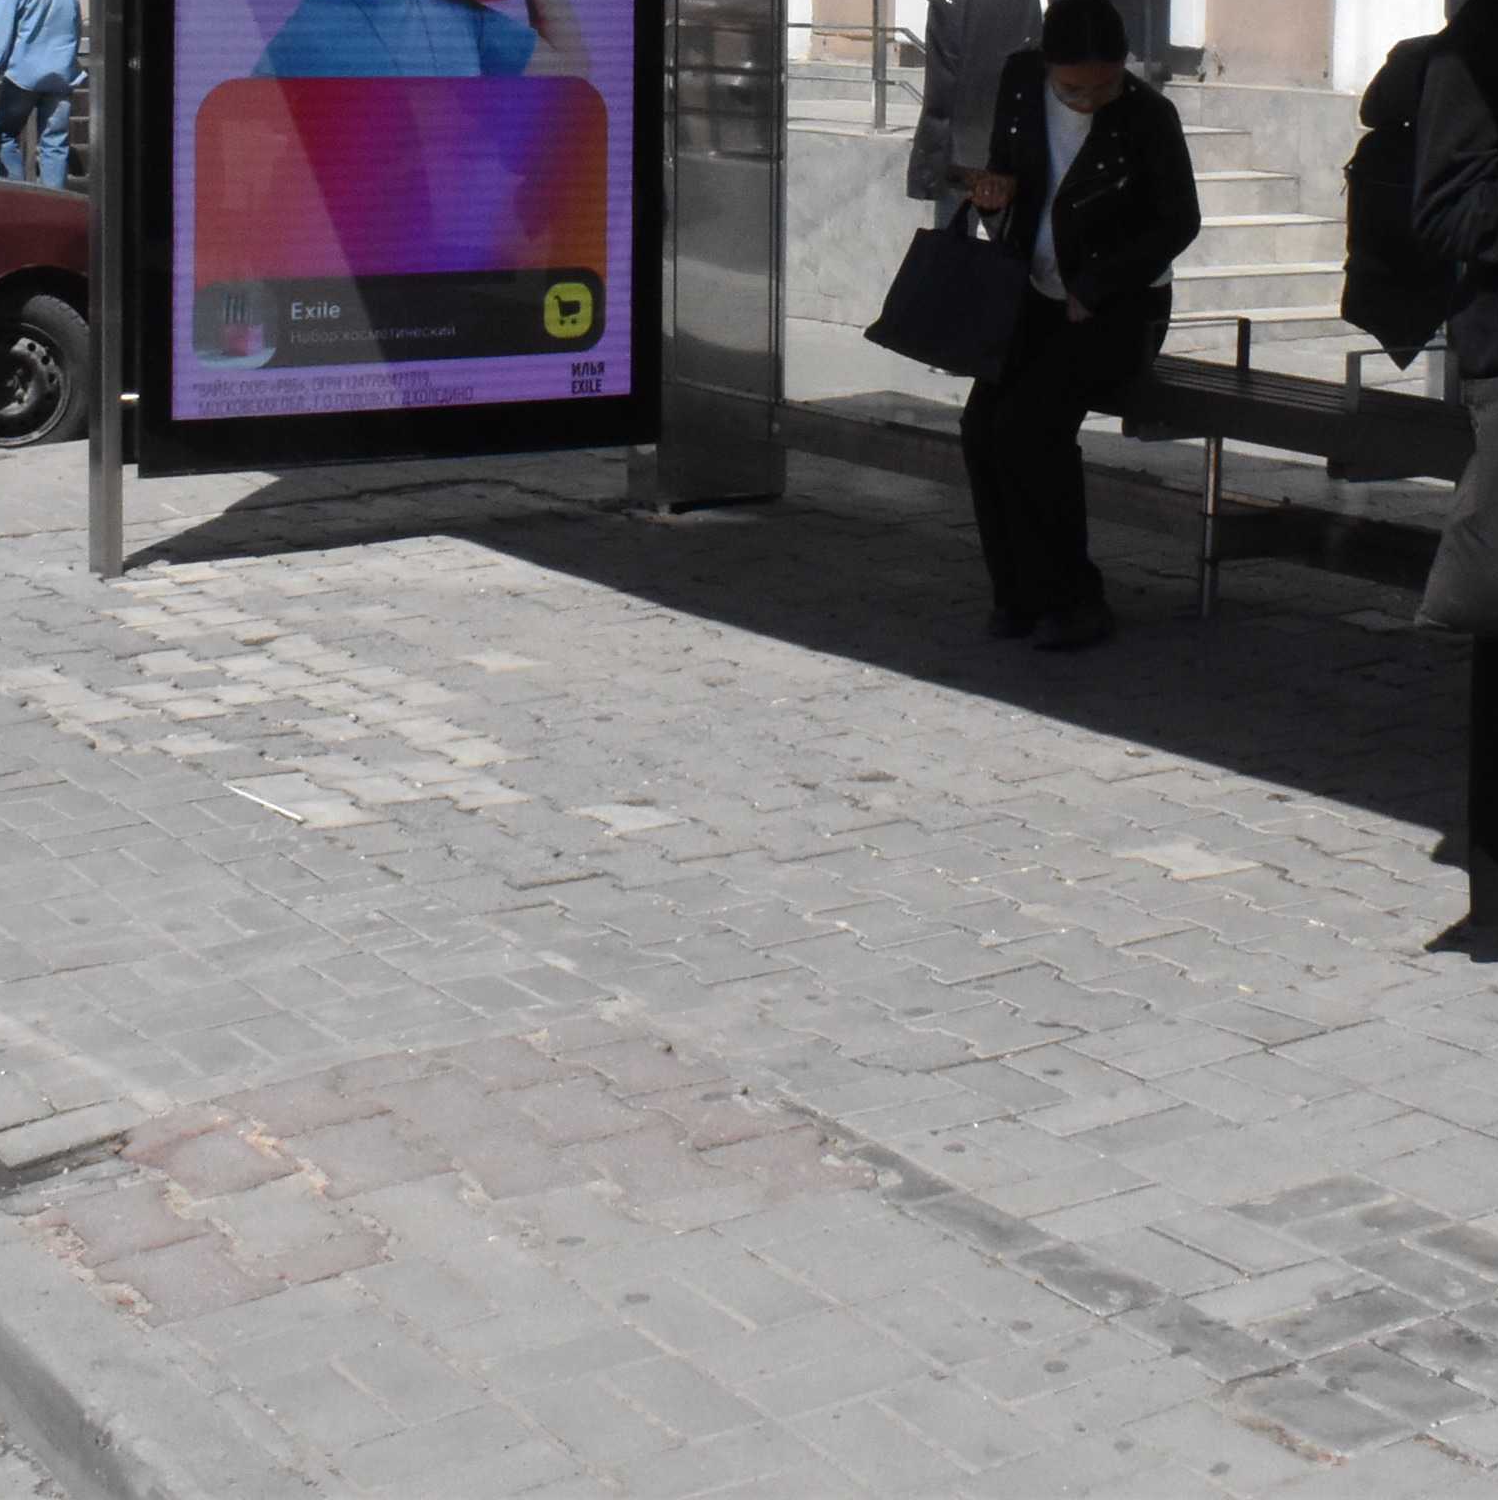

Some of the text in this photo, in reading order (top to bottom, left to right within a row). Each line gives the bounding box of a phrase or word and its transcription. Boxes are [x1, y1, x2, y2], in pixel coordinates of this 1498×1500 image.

[290, 301, 342, 321] Exile
[571, 361, 605, 378] ИЛЬЯ
[571, 378, 603, 395] EXILE
